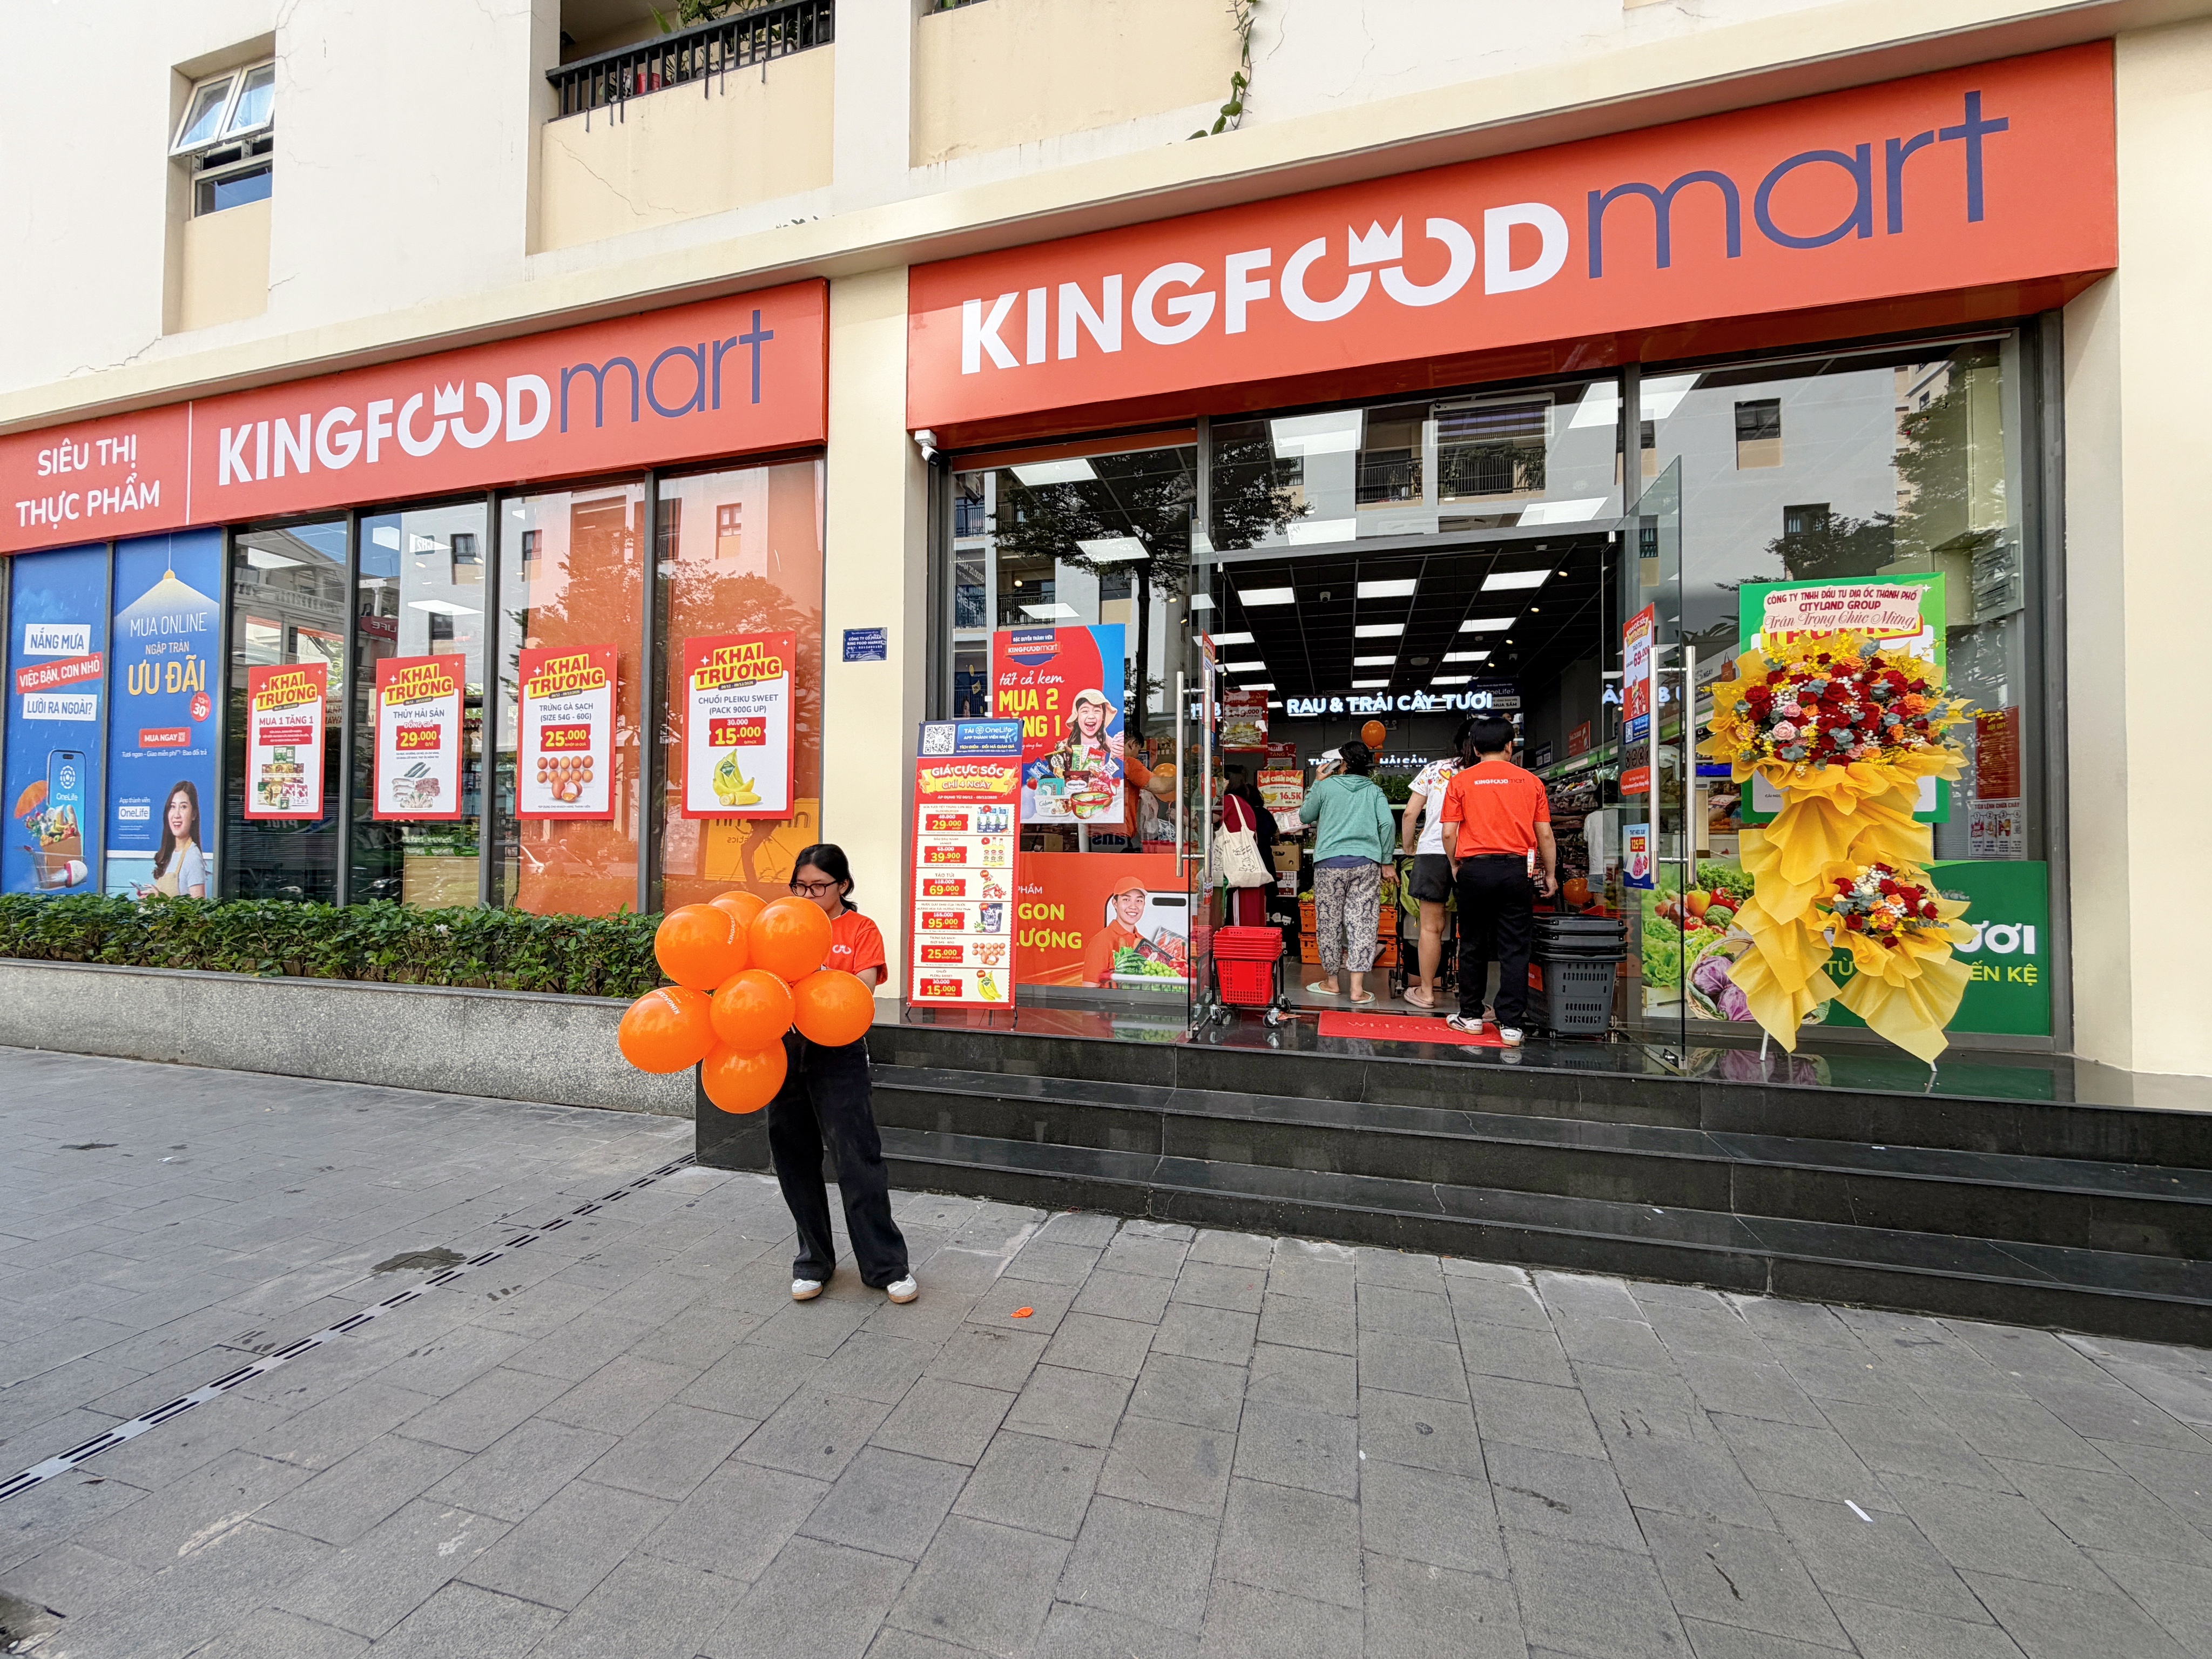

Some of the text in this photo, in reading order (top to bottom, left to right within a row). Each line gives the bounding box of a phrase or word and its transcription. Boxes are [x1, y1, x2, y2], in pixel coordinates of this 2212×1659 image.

[38, 434, 137, 476] SIÊU THỊ
[16, 473, 159, 529] THỰC PHẨM
[1767, 594, 1786, 604] CÔNG
[1789, 594, 1798, 602] TY
[1800, 591, 1818, 600] TNHH
[1901, 590, 1917, 601] PHỐ
[1799, 600, 1881, 612] CITYLAND GROUP
[130, 612, 207, 637] MUA ONLINE
[1765, 615, 1795, 629] Trân
[1798, 612, 1835, 627] Trọng
[1838, 611, 1869, 625] Chúc
[31, 627, 84, 650] NẮNG MƯA
[145, 639, 189, 656] NGẬP TRÀN
[715, 644, 761, 666] KHAI
[19, 670, 39, 687] VIỆC
[61, 663, 79, 679] CON
[81, 655, 100, 675] NHỎ
[547, 656, 587, 676] KHAI
[697, 658, 780, 686] TRƯƠNG
[129, 655, 205, 696] ƯU ĐÃI
[271, 673, 304, 691] KHAI
[402, 666, 438, 684] KHAI
[530, 669, 604, 694] TRƯƠNG
[1000, 669, 1065, 686] tất cả kem
[258, 685, 316, 707] TRƯƠNG
[387, 678, 452, 702] TRƯƠNG
[27, 698, 93, 714] LƯỜI RA NGOÀI?
[539, 702, 594, 711] TRỨNG GÀ SẠCH
[698, 694, 722, 704] CHUỐI
[752, 694, 779, 702] SWEET
[999, 688, 1058, 712] MUA 2
[1287, 698, 1327, 714] RAU
[1330, 697, 1344, 713] &
[1346, 692, 1393, 712] TRÁI
[1398, 690, 1435, 711] CÂY
[1442, 691, 1492, 710] TƯƠI
[415, 708, 427, 718] HẢI
[429, 707, 444, 717] SẢN
[541, 714, 556, 723] (SIZE
[709, 707, 731, 716] (PACK
[754, 705, 766, 713] UP)
[259, 717, 276, 726] MUA
[309, 716, 314, 724] 1
[423, 719, 434, 728] GIÁ
[1054, 714, 1060, 737] 1
[400, 730, 437, 747] 29.000
[545, 729, 586, 747] 25.000
[714, 726, 761, 745] 15.000
[932, 763, 1004, 778] GIÁ CỰC SỐC
[967, 779, 992, 789] NGÀY
[56, 792, 78, 801] OneLife
[120, 808, 149, 817] OneLife
[932, 820, 961, 830] 29.000
[930, 852, 960, 862] 39.900
[929, 885, 959, 895] 69.000
[928, 918, 958, 928] 95.000
[927, 949, 957, 959] 25.000
[2007, 964, 2038, 987] KỆ
[927, 985, 956, 995] 15.000
